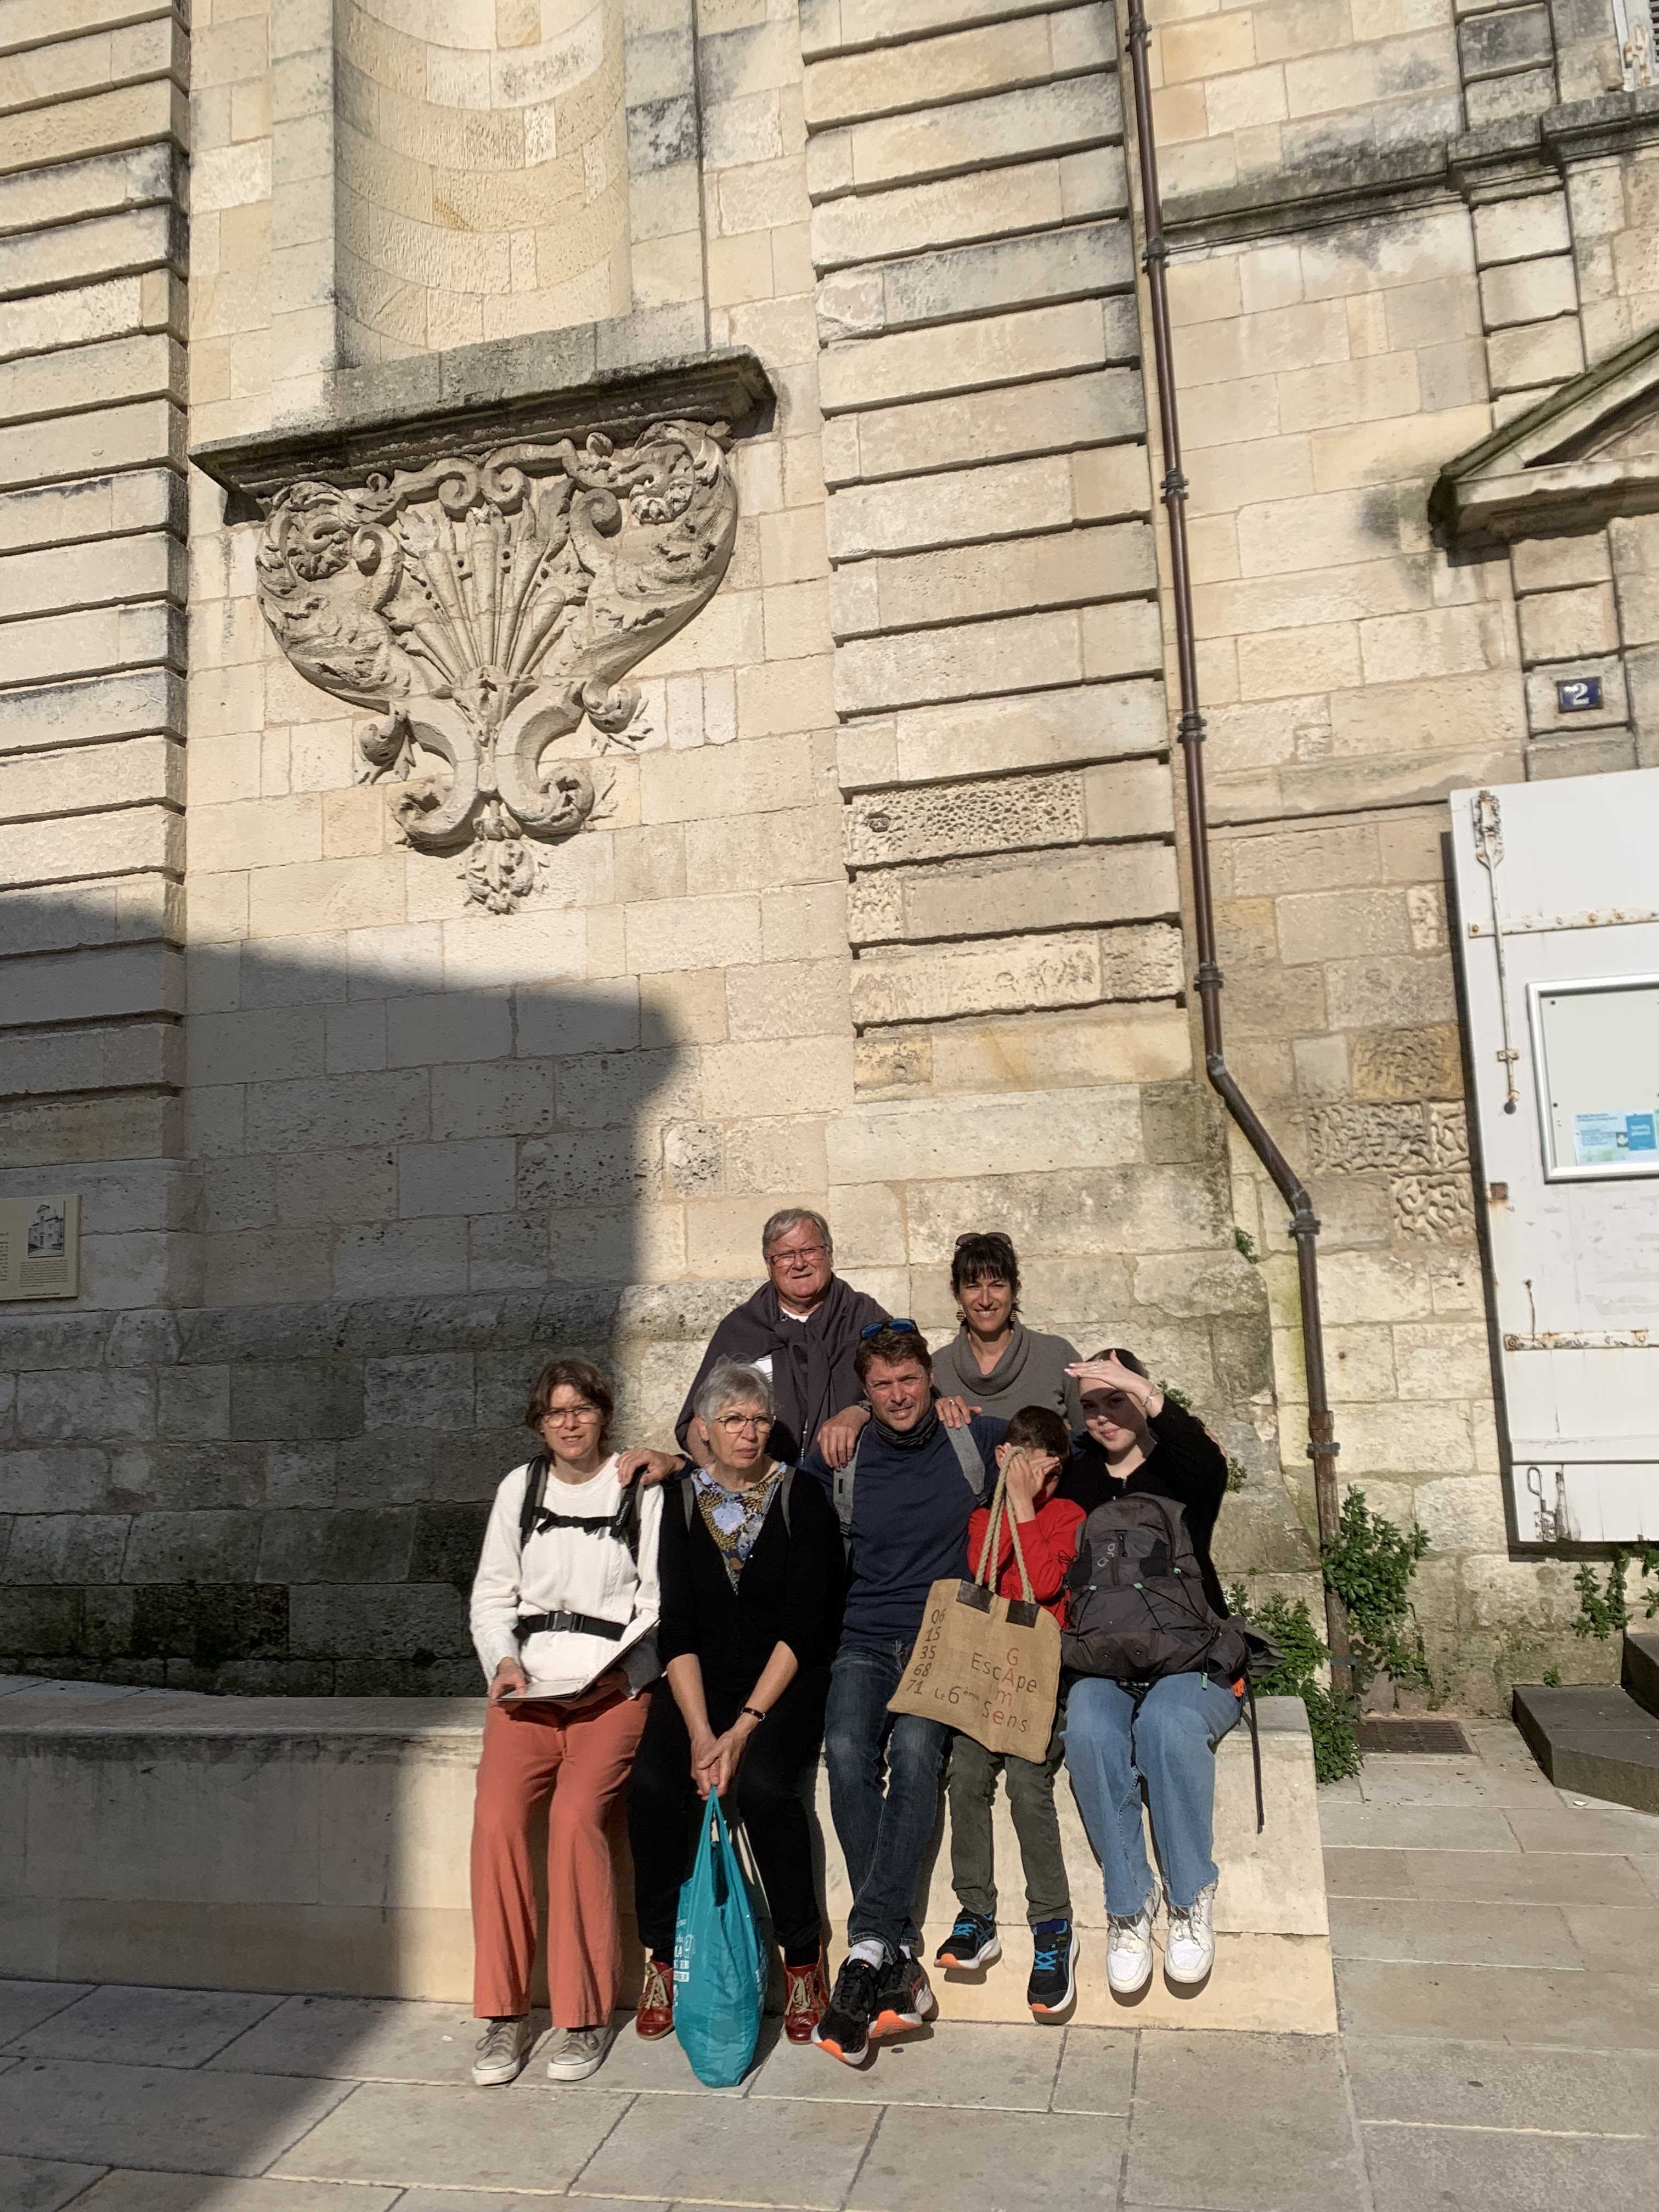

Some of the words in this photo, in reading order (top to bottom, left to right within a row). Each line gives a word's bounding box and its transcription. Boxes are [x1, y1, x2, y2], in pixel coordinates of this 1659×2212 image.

[1571, 682, 1590, 706] 2
[931, 1609, 946, 1624] 06
[924, 1626, 941, 1641] 15
[919, 1645, 936, 1660] 35
[913, 1662, 932, 1677] 68
[906, 1679, 924, 1695] 71
[934, 1688, 945, 1700] Le
[982, 1701, 1028, 1733] Sens
